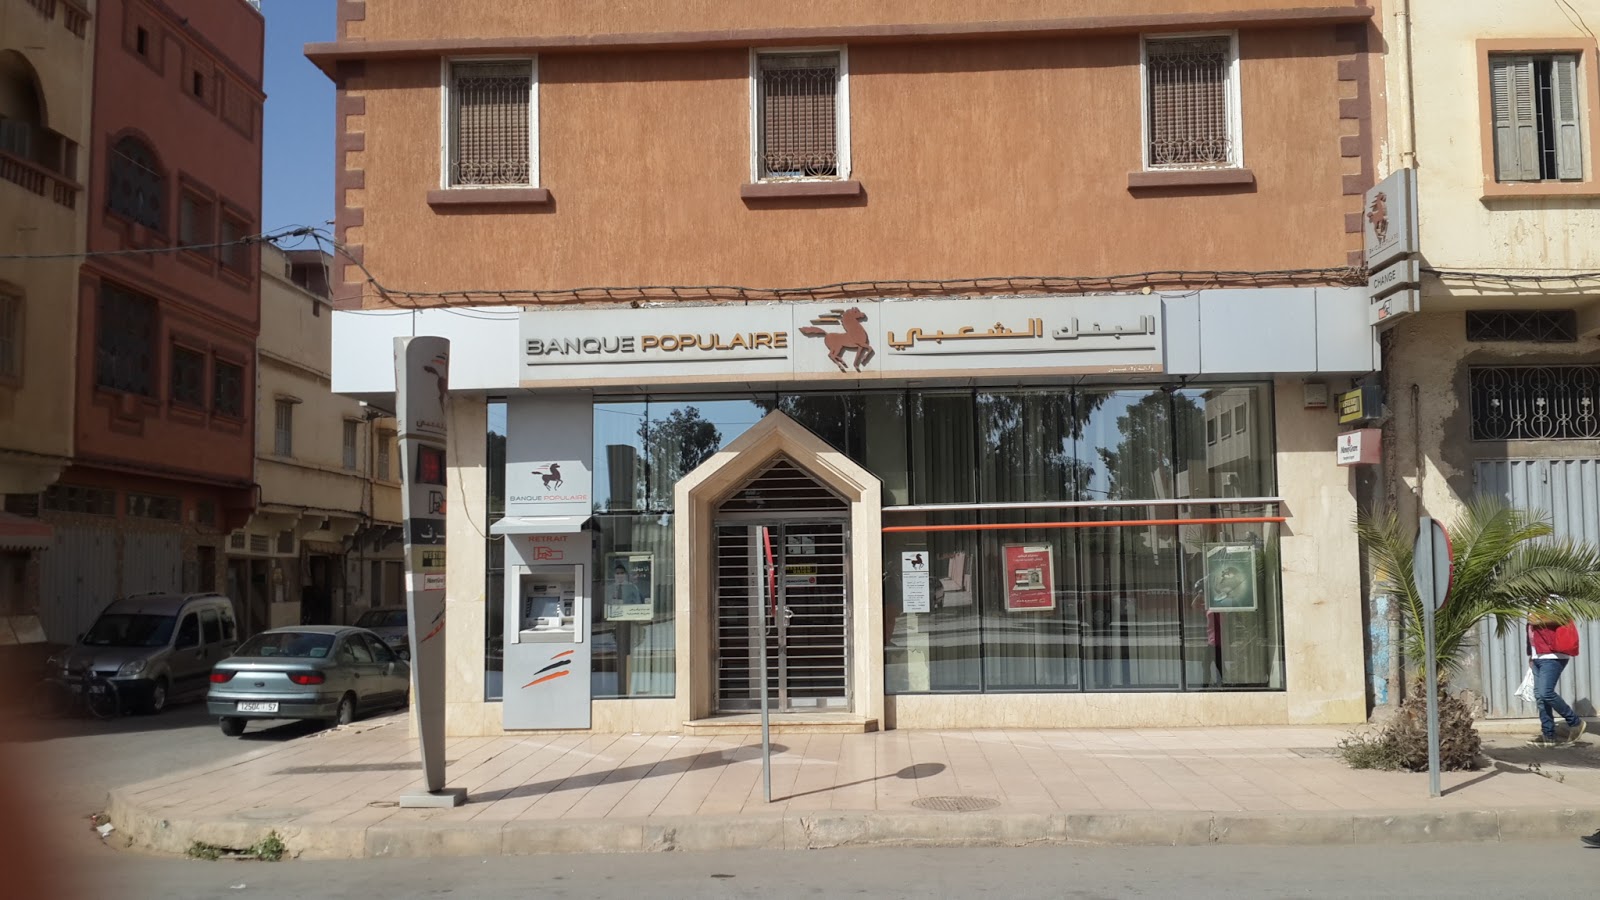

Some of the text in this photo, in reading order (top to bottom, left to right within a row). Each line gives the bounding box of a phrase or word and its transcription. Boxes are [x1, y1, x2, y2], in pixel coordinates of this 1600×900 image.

[1373, 269, 1396, 289] CHANGE
[525, 331, 788, 355] BANQUE POPULAIRE
[887, 315, 1156, 351] البنك الشعبي
[528, 535, 568, 543] RETRAIT
